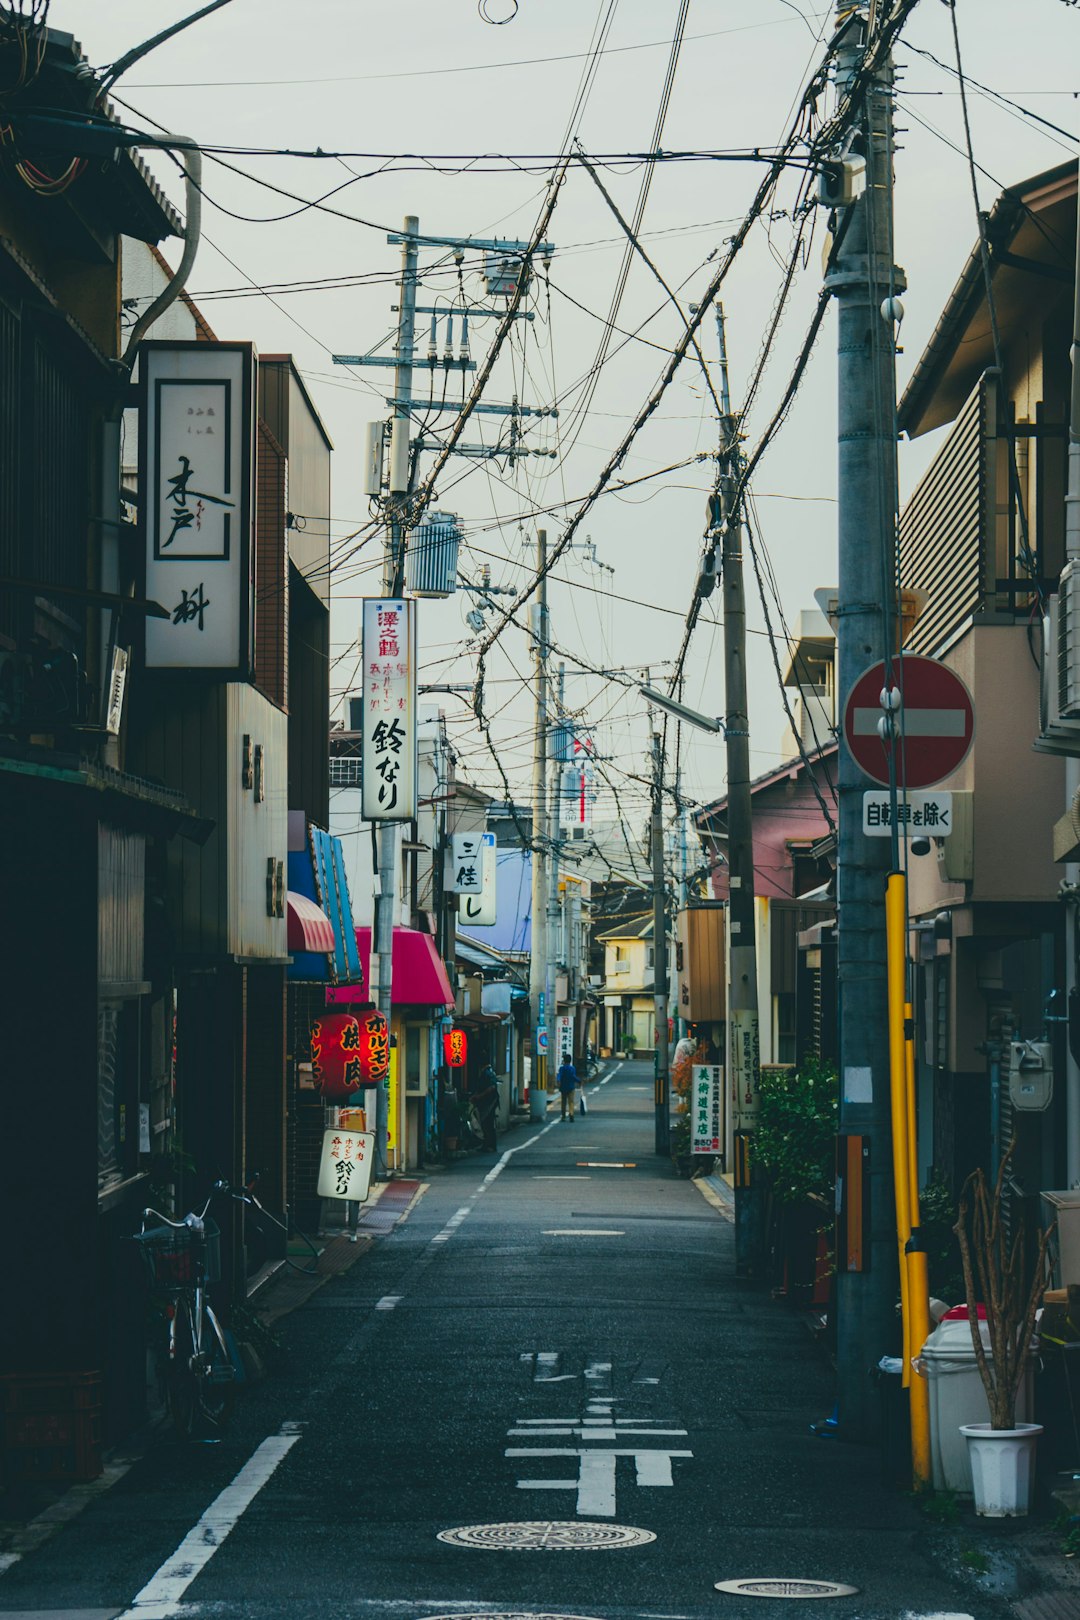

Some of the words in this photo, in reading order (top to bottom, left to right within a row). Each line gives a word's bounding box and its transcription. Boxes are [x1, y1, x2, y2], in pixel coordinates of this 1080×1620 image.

[161, 456, 236, 549] 木戸
[371, 718, 406, 811] 鈴なり
[867, 802, 949, 826] 自転車を除く
[341, 1022, 360, 1086] 焼肉
[366, 1015, 388, 1079] ホルモン
[697, 1067, 710, 1135] 美術道具店
[335, 1160, 355, 1195] 鈴なり
